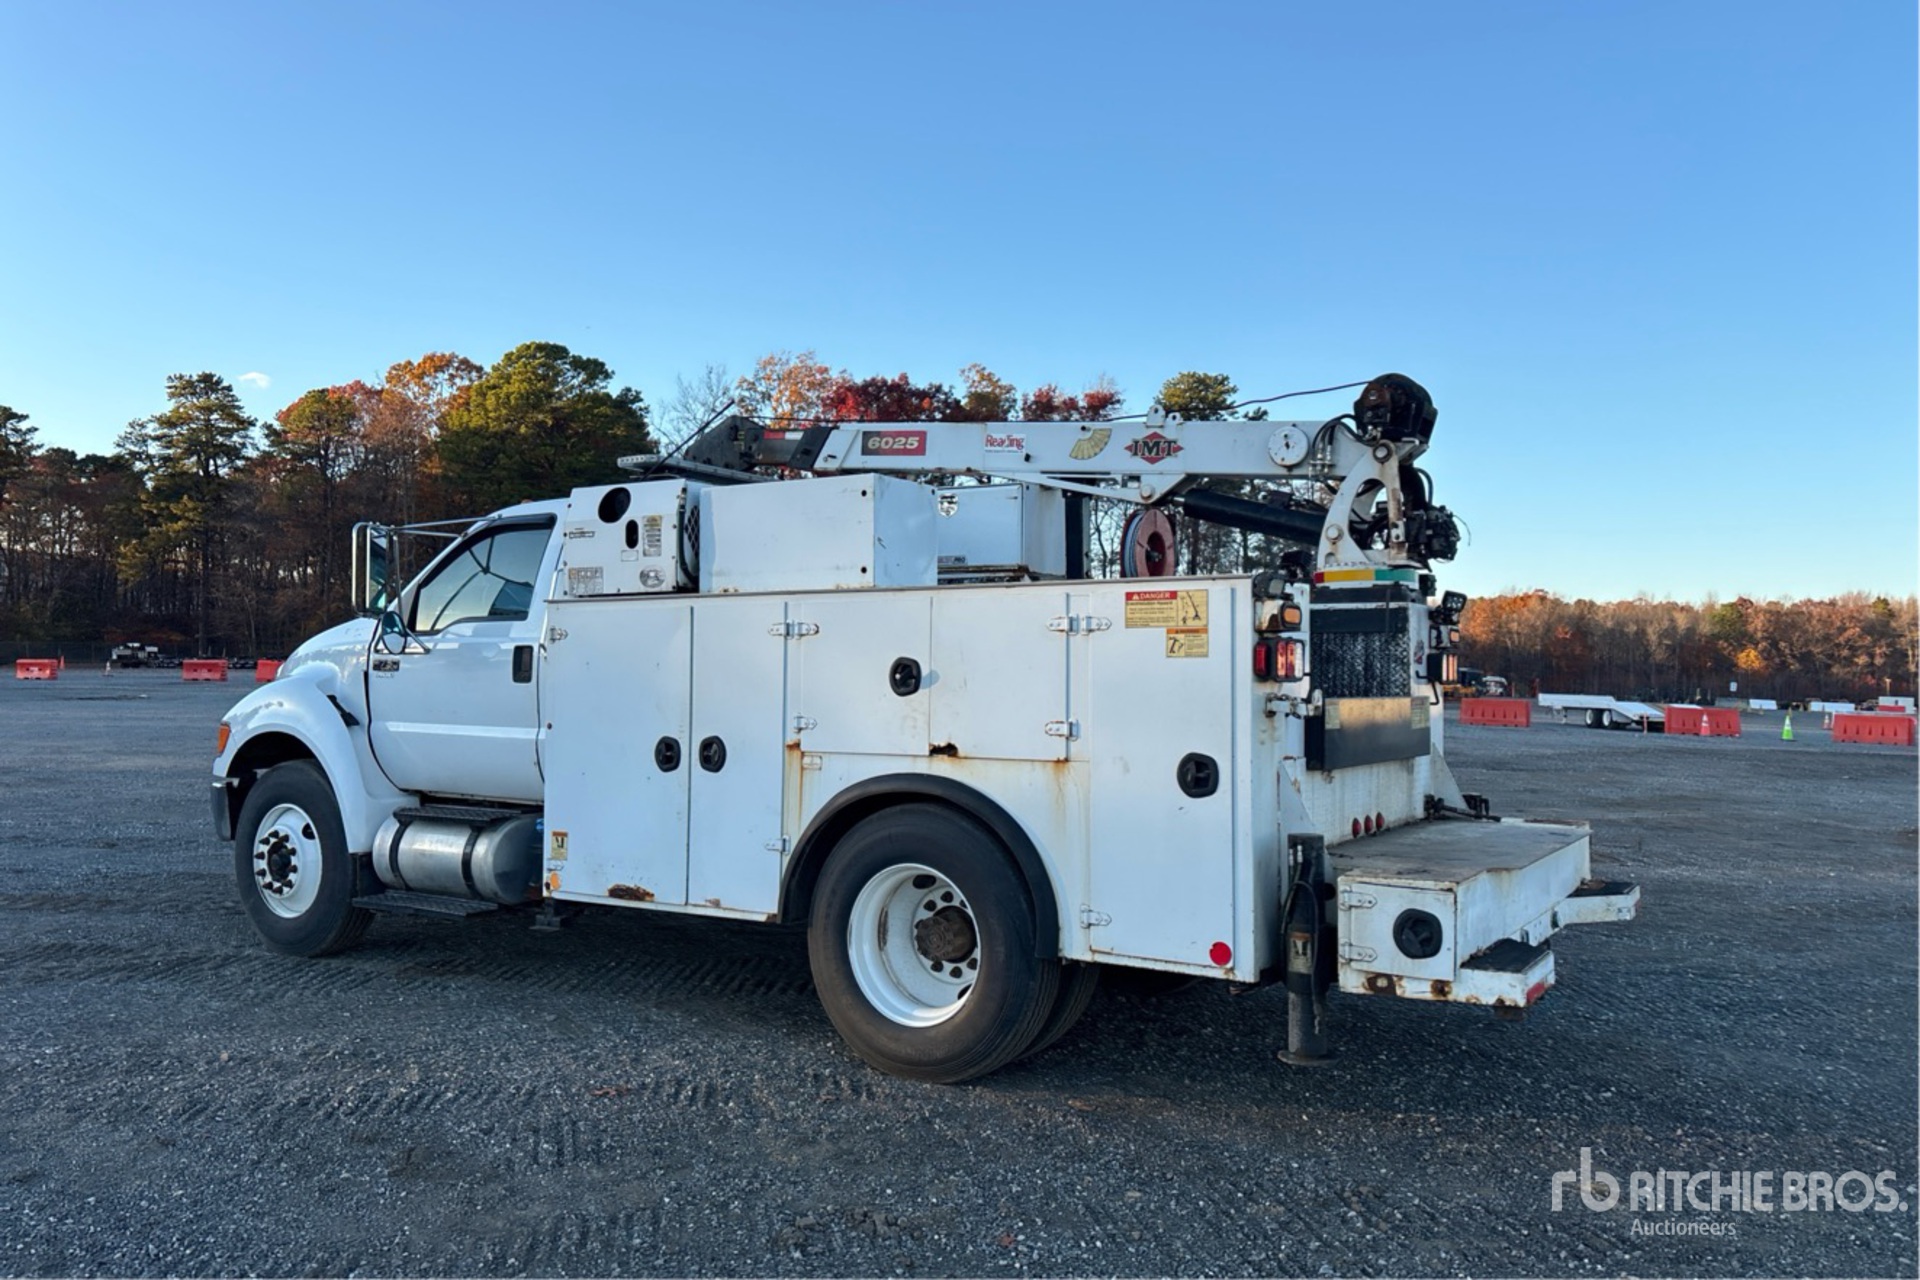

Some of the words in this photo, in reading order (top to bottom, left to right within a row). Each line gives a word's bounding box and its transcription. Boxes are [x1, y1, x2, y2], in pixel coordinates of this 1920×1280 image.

[867, 436, 920, 449] 6025
[1131, 438, 1179, 457] IMT
[1139, 592, 1171, 600] DANGER
